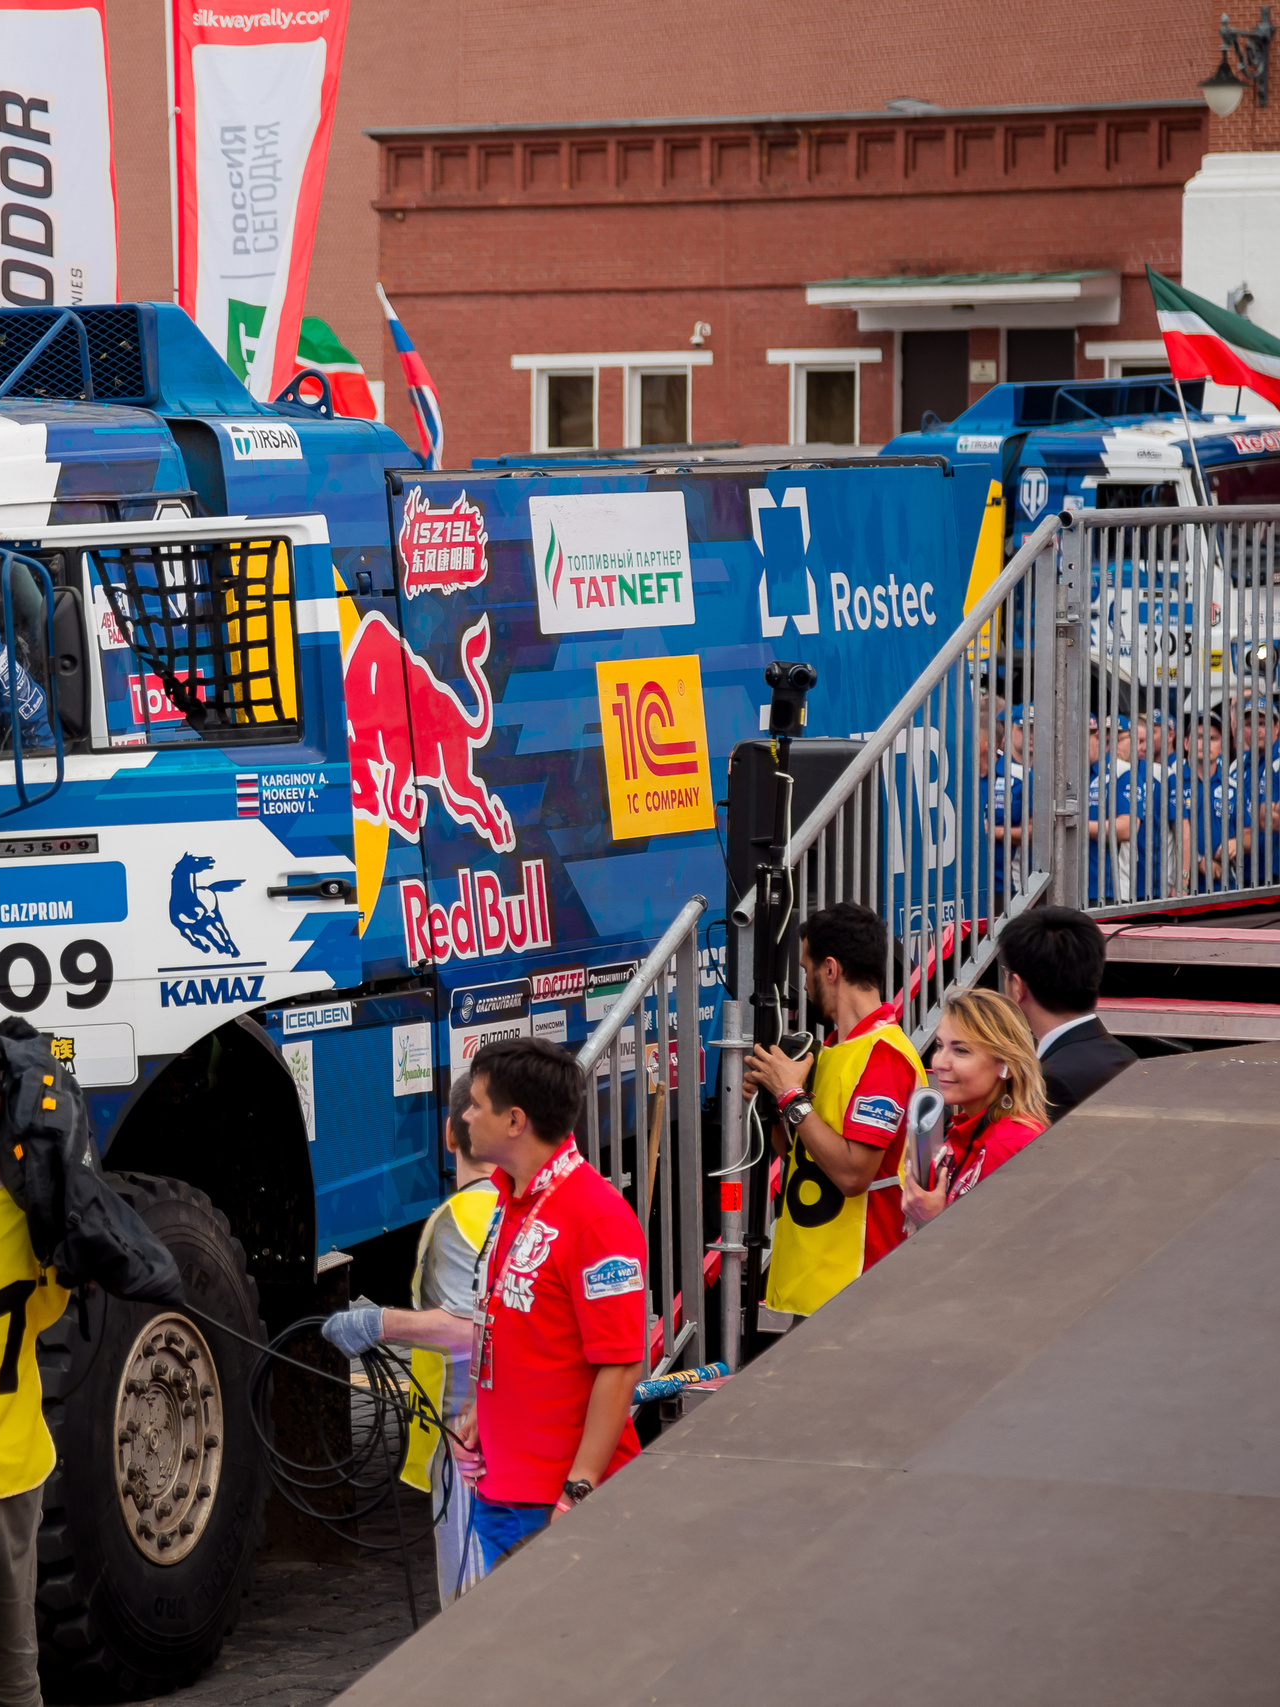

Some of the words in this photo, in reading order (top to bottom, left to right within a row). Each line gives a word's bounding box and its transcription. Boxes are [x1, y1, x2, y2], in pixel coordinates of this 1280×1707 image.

[412, 546, 475, 573] 东风康明斯
[567, 549, 633, 571] ТОПЛИВНЫЙ
[637, 550, 682, 568] ПАРТНЕР
[570, 571, 683, 608] TATNEFT
[830, 572, 937, 631] Rostec
[262, 773, 315, 786] KARGINOV
[319, 772, 329, 784] A.
[263, 788, 305, 800] MOKEEV
[308, 787, 318, 798] A.
[627, 793, 639, 814] 1C
[645, 787, 699, 812] COMPANY
[264, 801, 305, 814] LEONOV
[4, 839, 90, 855] 43509
[0, 901, 73, 922] GAZPROM
[401, 869, 478, 966] Red
[475, 860, 550, 956] Bull
[160, 976, 267, 1008] KAMAZ
[533, 972, 583, 999] LOCTITE
[285, 1006, 349, 1029] ICEQUEEN
[535, 1020, 565, 1031] OMNICOMM
